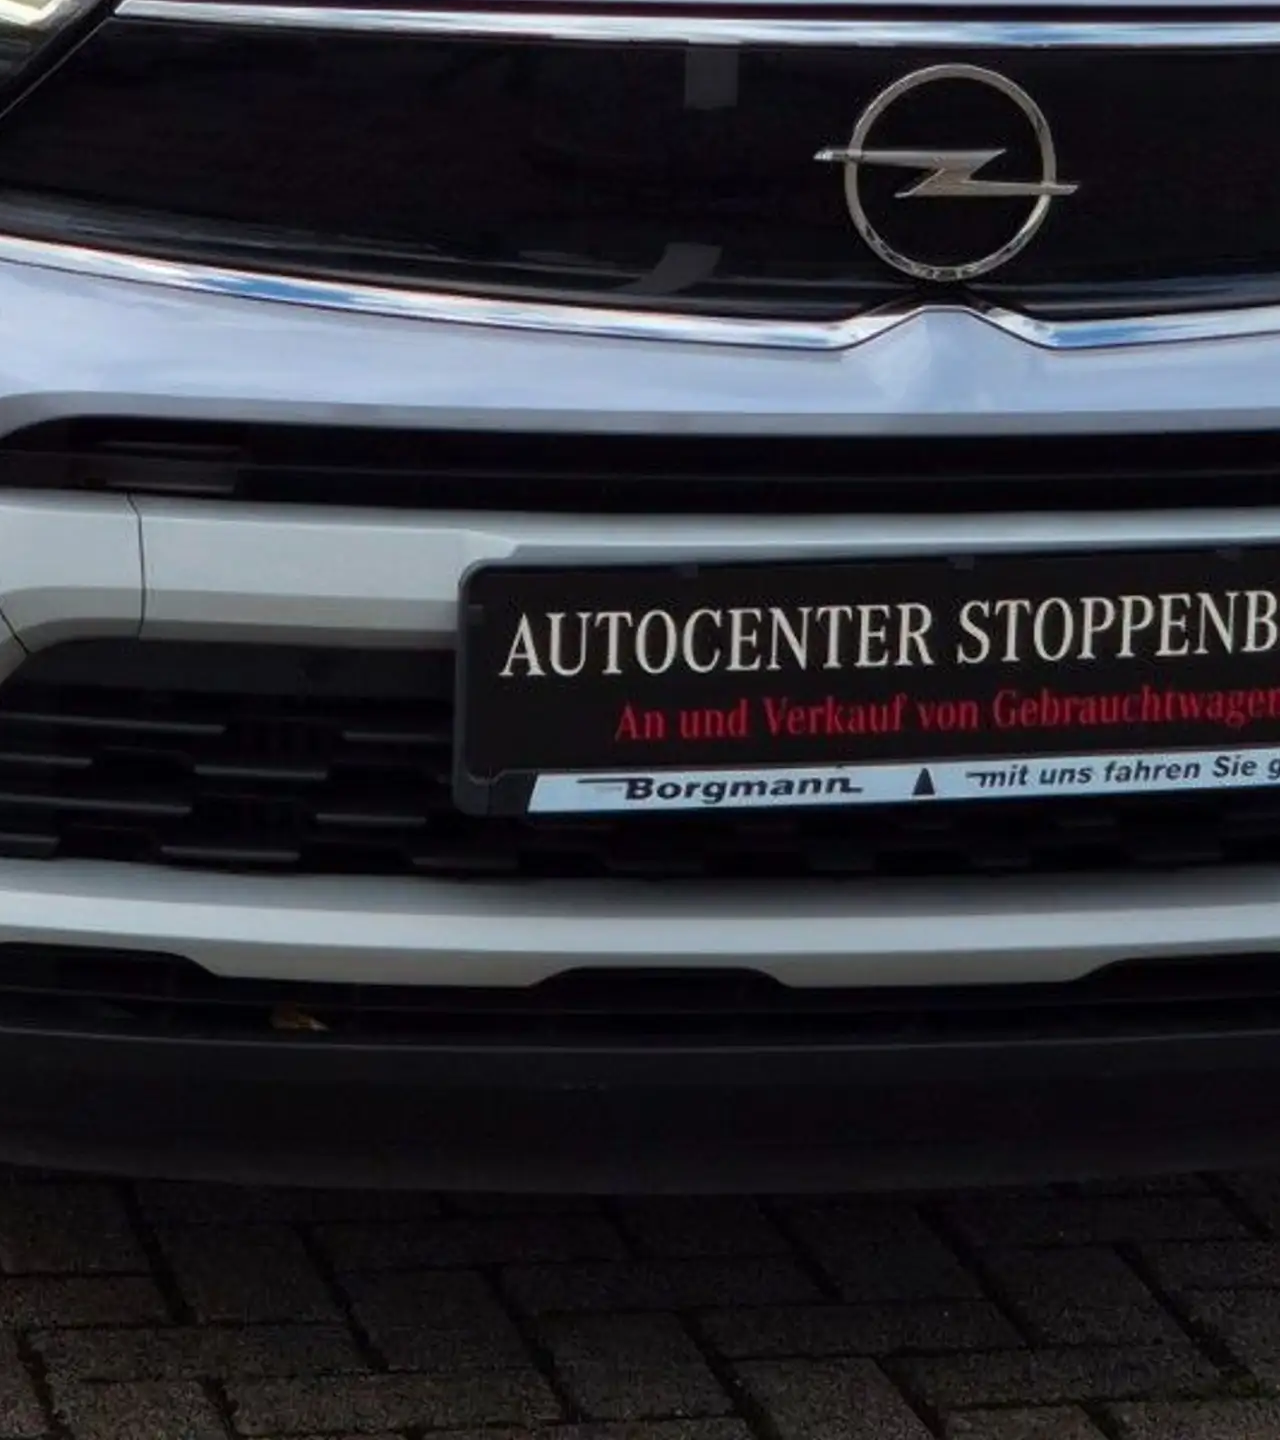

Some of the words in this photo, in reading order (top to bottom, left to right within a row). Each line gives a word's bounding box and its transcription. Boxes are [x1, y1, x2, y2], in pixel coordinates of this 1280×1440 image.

[499, 602, 936, 678] AUTOCENTER
[614, 700, 666, 741] An
[680, 696, 750, 739] und
[763, 692, 908, 736] Verkauf
[917, 699, 980, 731] von
[577, 774, 863, 804] Borgmann
[966, 763, 1029, 788] mit
[1039, 766, 1093, 786] uns
[1104, 758, 1201, 785] fahren
[1212, 753, 1257, 778] Sie
